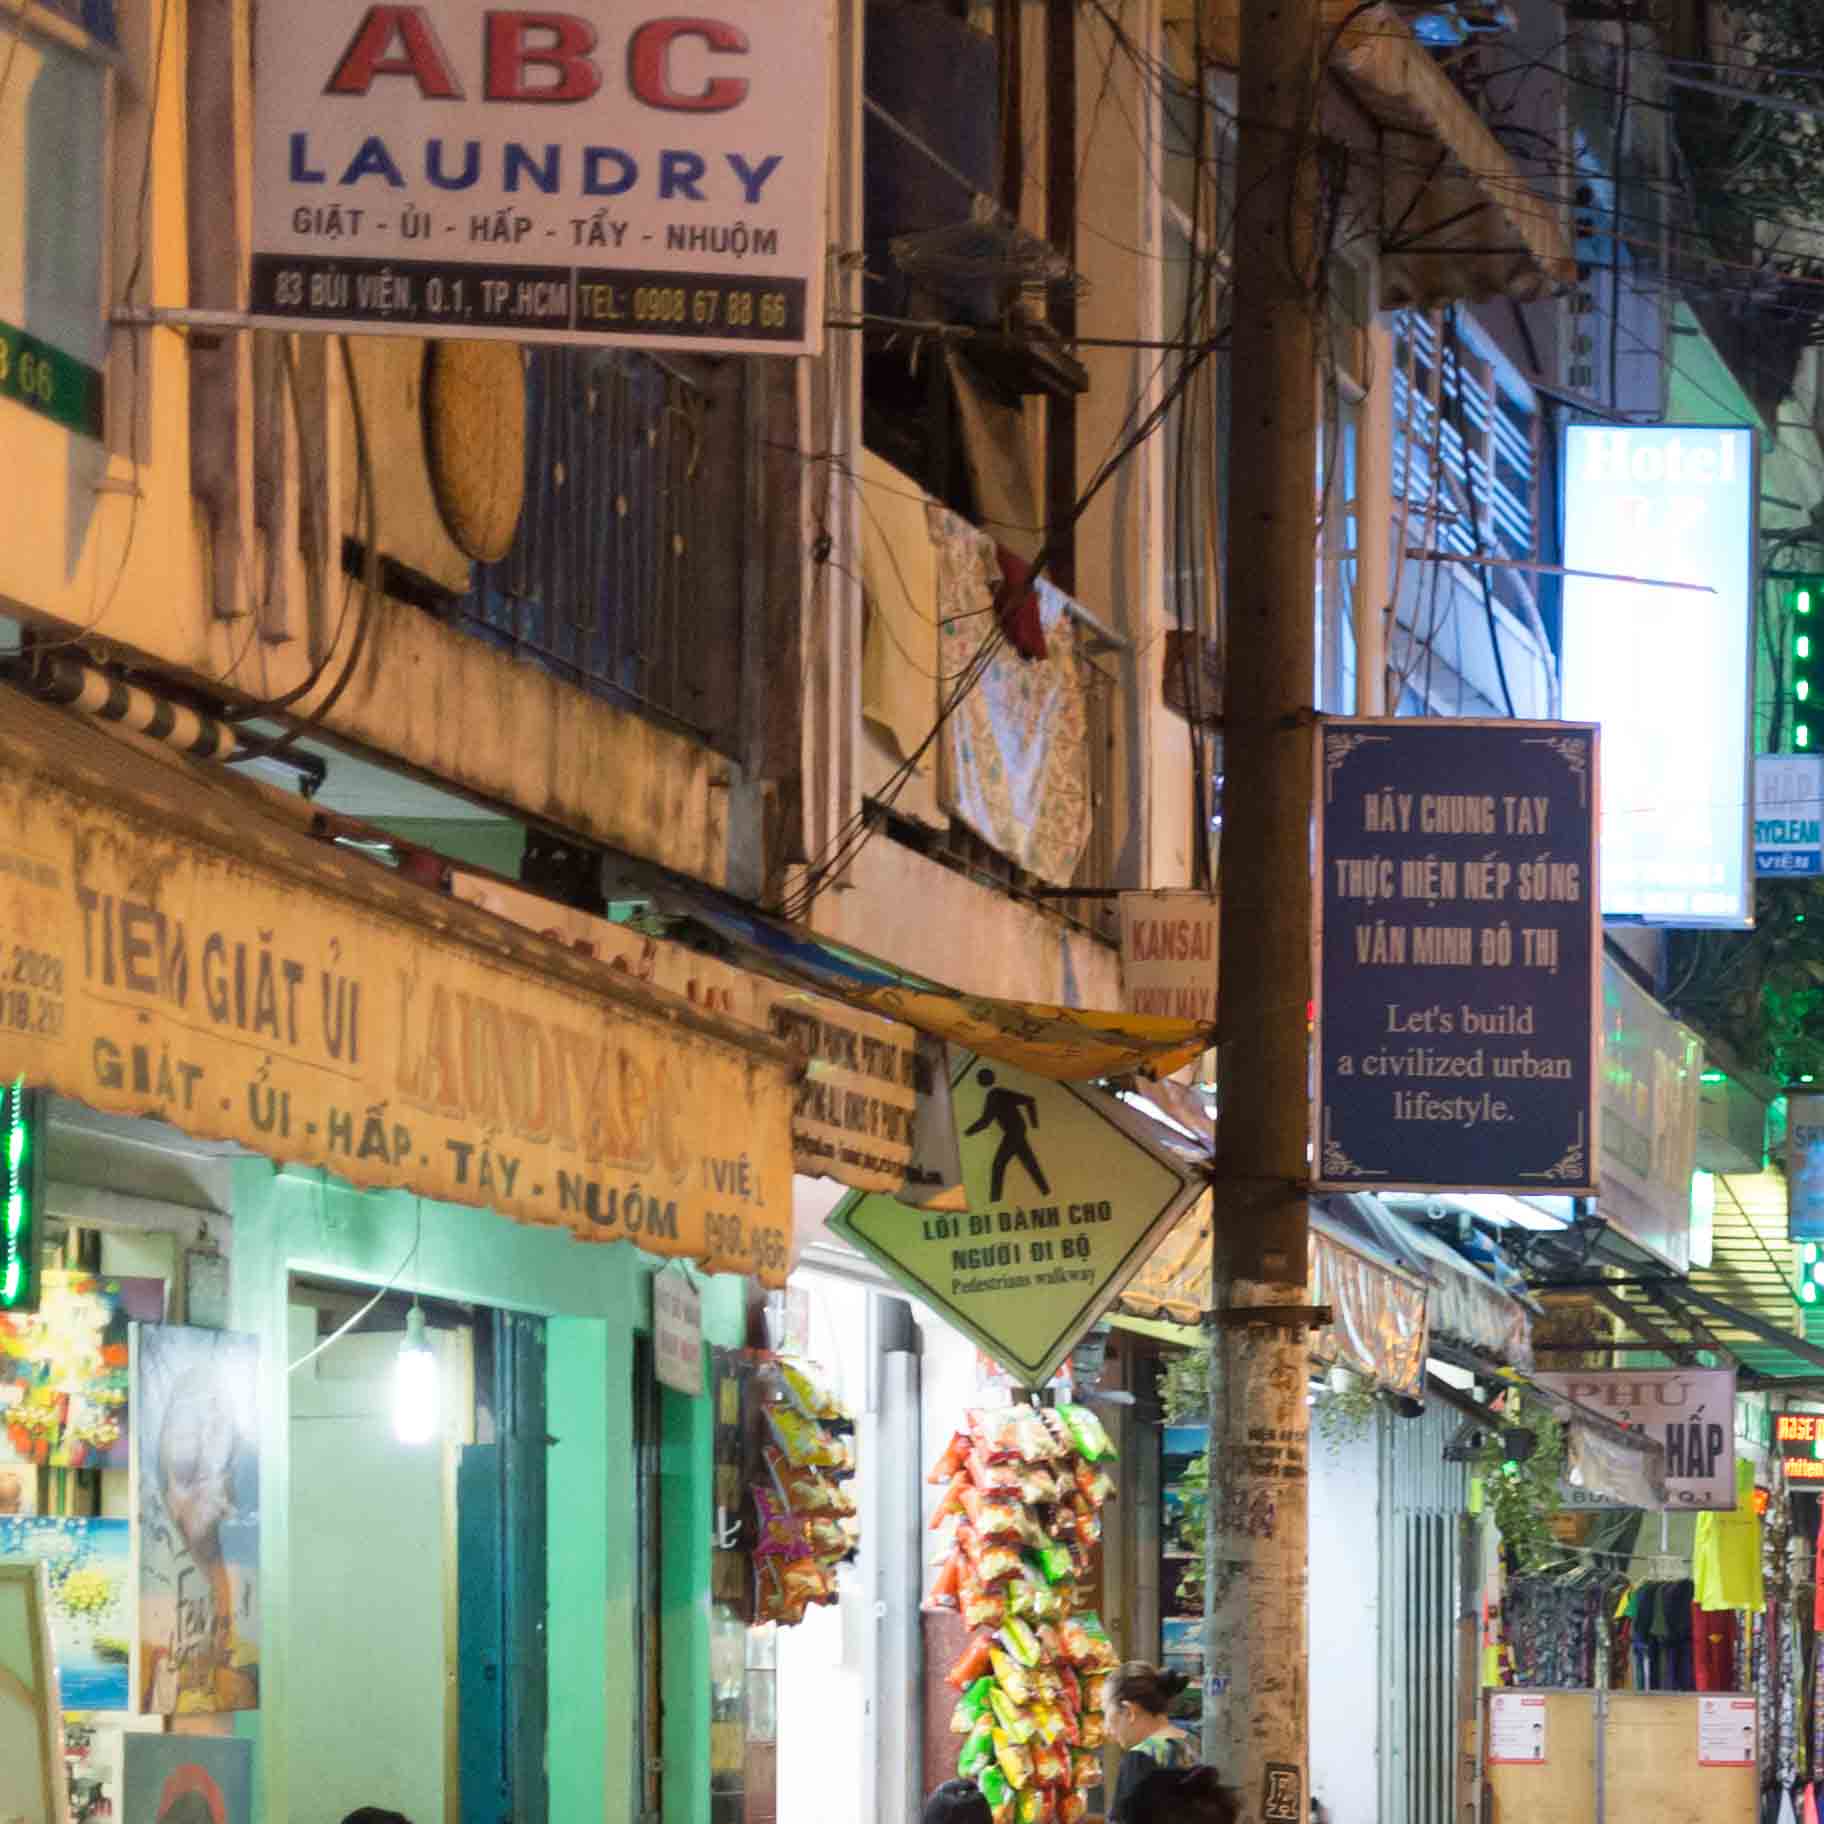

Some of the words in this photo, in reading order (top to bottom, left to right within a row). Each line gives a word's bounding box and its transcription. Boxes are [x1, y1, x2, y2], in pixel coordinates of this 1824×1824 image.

[322, 5, 750, 114] ABC
[289, 133, 784, 203] LAUNDRY
[1583, 431, 1737, 483] Hotel
[1363, 786, 1413, 833] HÃY
[1420, 794, 1496, 834] CHUNG
[1503, 796, 1550, 835] TAY
[1401, 853, 1457, 909] HIỆN
[1517, 851, 1580, 903] SỐNG
[1134, 919, 1213, 961] KANSAI
[1412, 926, 1473, 967] MINH
[1480, 920, 1512, 968] ĐÔ
[1521, 928, 1559, 975] THỊ
[1386, 1004, 1455, 1034] Let's
[1461, 1005, 1535, 1036] build
[1337, 1055, 1353, 1077] a
[1361, 1048, 1484, 1079] civilized
[1492, 1050, 1572, 1080] urban
[1392, 1089, 1515, 1129] lifestyle.
[1068, 1201, 1112, 1224] CHO
[952, 1271, 1032, 1295] Pedestrians
[1037, 1266, 1095, 1287] walkway
[1666, 1404, 1724, 1479] HẤP
